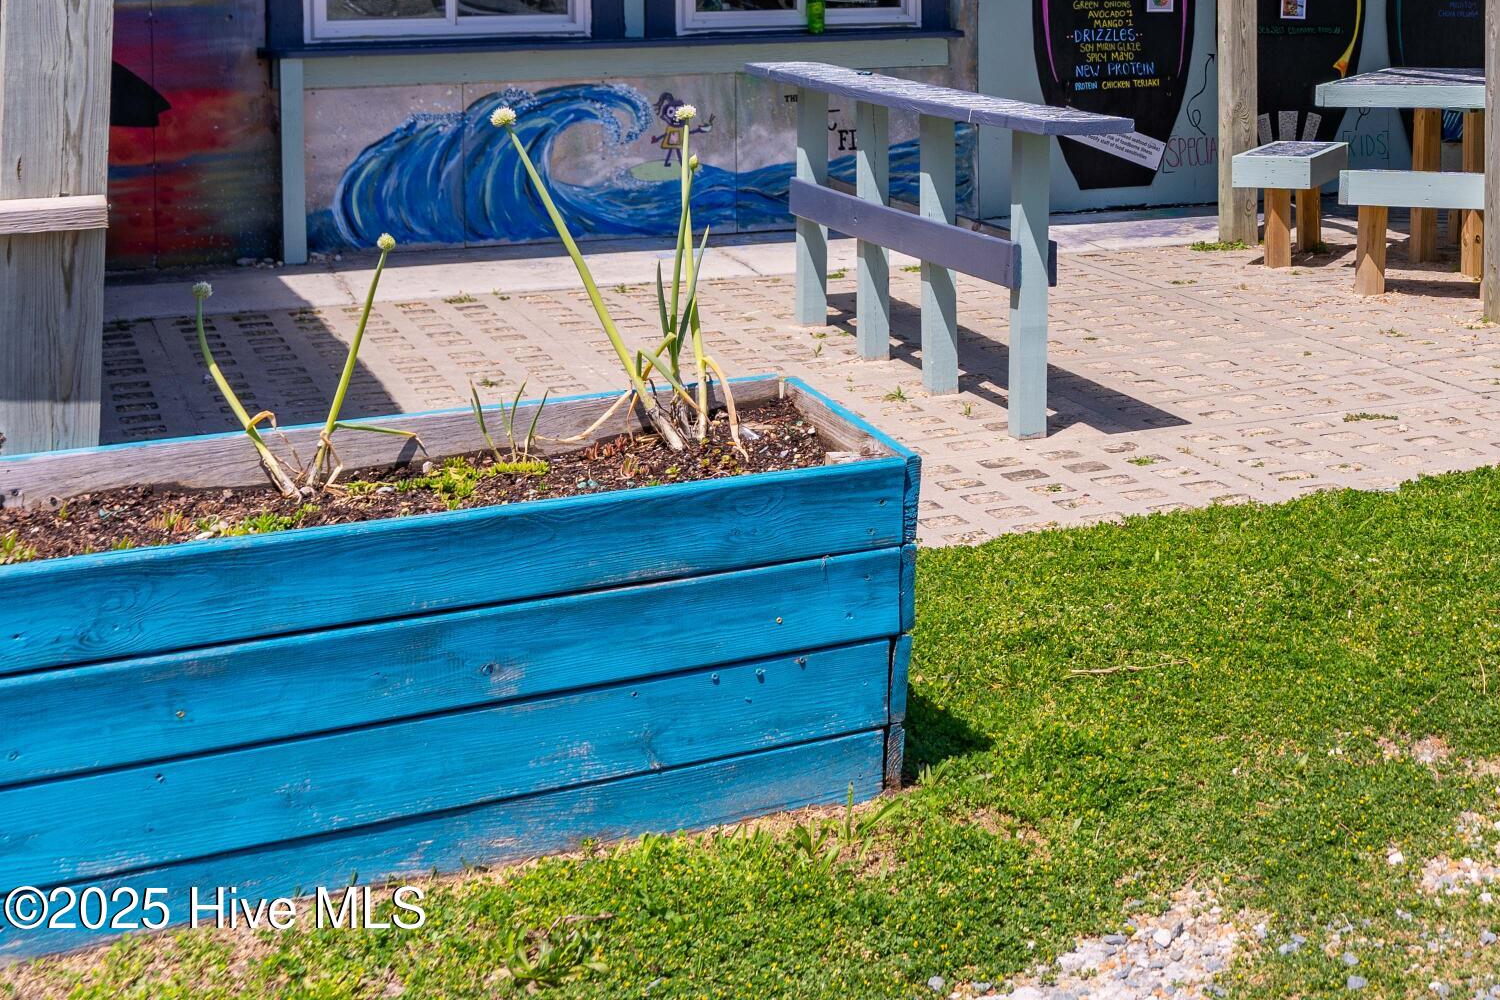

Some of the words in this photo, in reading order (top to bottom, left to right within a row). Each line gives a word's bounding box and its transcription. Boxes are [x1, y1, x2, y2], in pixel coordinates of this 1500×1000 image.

[1104, 0, 1132, 8] ONIONS
[1087, 10, 1126, 19] AVOCADO
[1093, 19, 1124, 28] MANGO
[1080, 43, 1095, 53] SOY
[1096, 43, 1116, 52] MIRIN
[1086, 52, 1107, 62] SPICY
[1101, 81, 1131, 89] CHICKEN
[1348, 133, 1387, 157] KIDS
